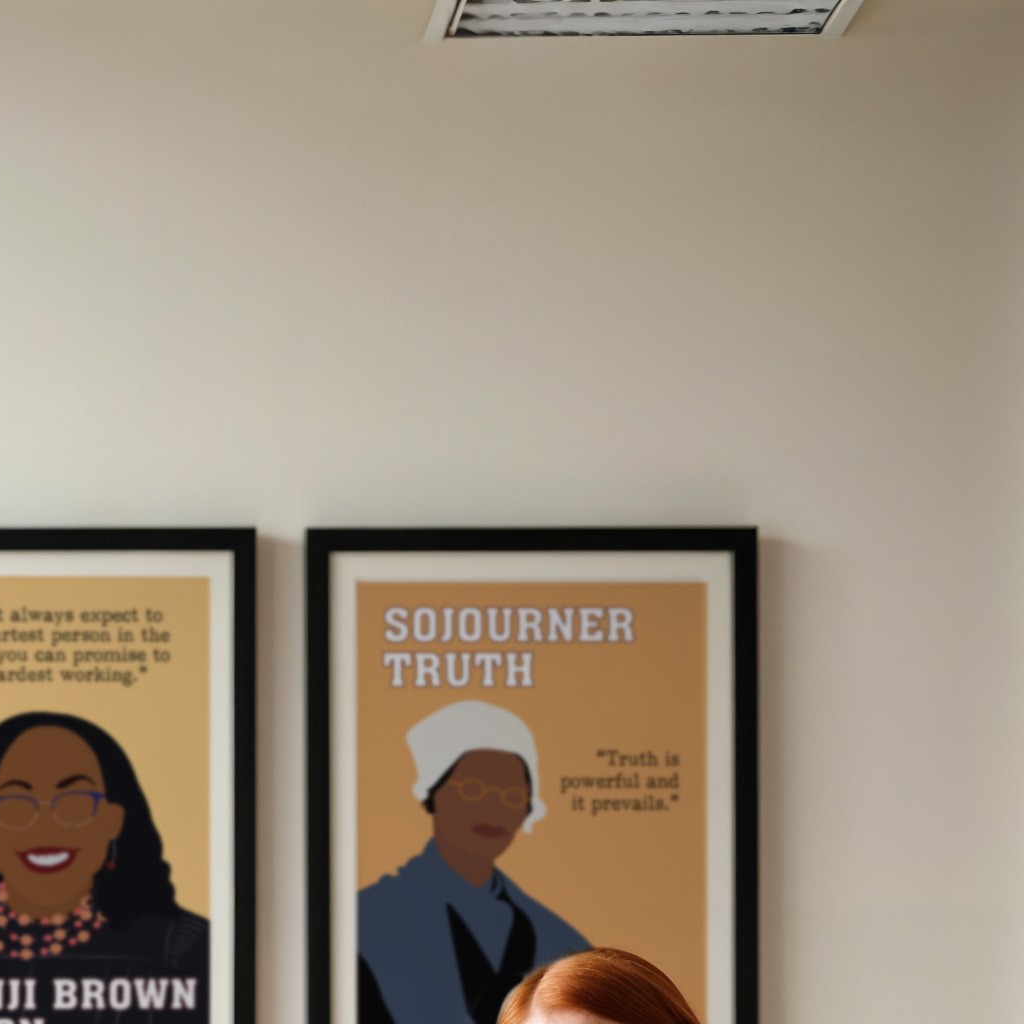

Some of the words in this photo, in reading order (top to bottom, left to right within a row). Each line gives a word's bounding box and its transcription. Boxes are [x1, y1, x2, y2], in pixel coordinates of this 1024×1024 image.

[10, 607, 74, 626] always
[80, 609, 138, 627] expect
[145, 608, 164, 623] to
[383, 606, 636, 643] SOJOURNER
[51, 630, 111, 647] person
[117, 627, 134, 642] in
[141, 627, 170, 642] the
[34, 650, 66, 662] can
[72, 648, 147, 667] promise
[153, 648, 171, 662] to
[382, 651, 535, 689] TRUTH
[665, 750, 680, 767] is
[560, 772, 640, 793] powerful
[646, 772, 679, 789] and
[572, 795, 585, 811] it
[53, 978, 197, 1010] BROWN
